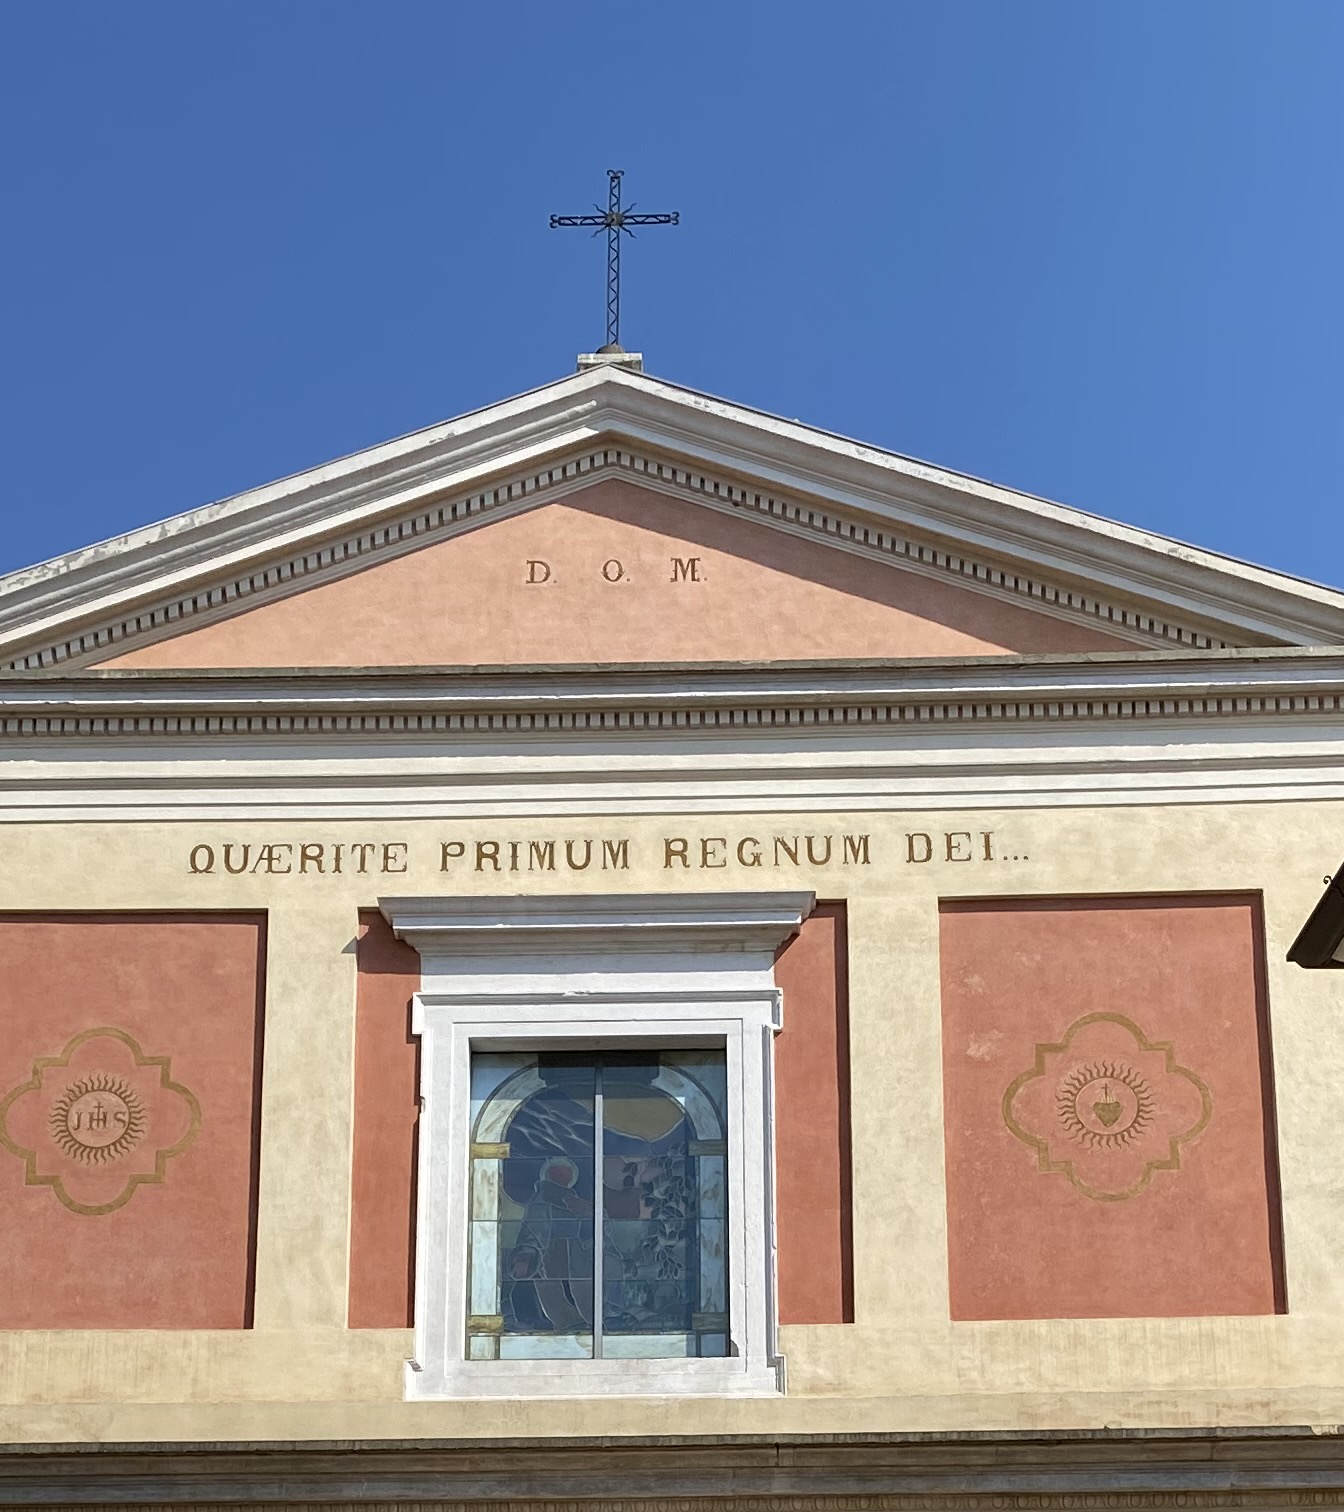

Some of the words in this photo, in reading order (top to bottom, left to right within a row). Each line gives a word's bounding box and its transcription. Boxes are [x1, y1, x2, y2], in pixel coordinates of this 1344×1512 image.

[187, 842, 408, 874] QUÆRITE
[439, 839, 631, 873] PRIMUM
[662, 834, 872, 869] REGNUM
[904, 831, 1030, 864] DEI...
